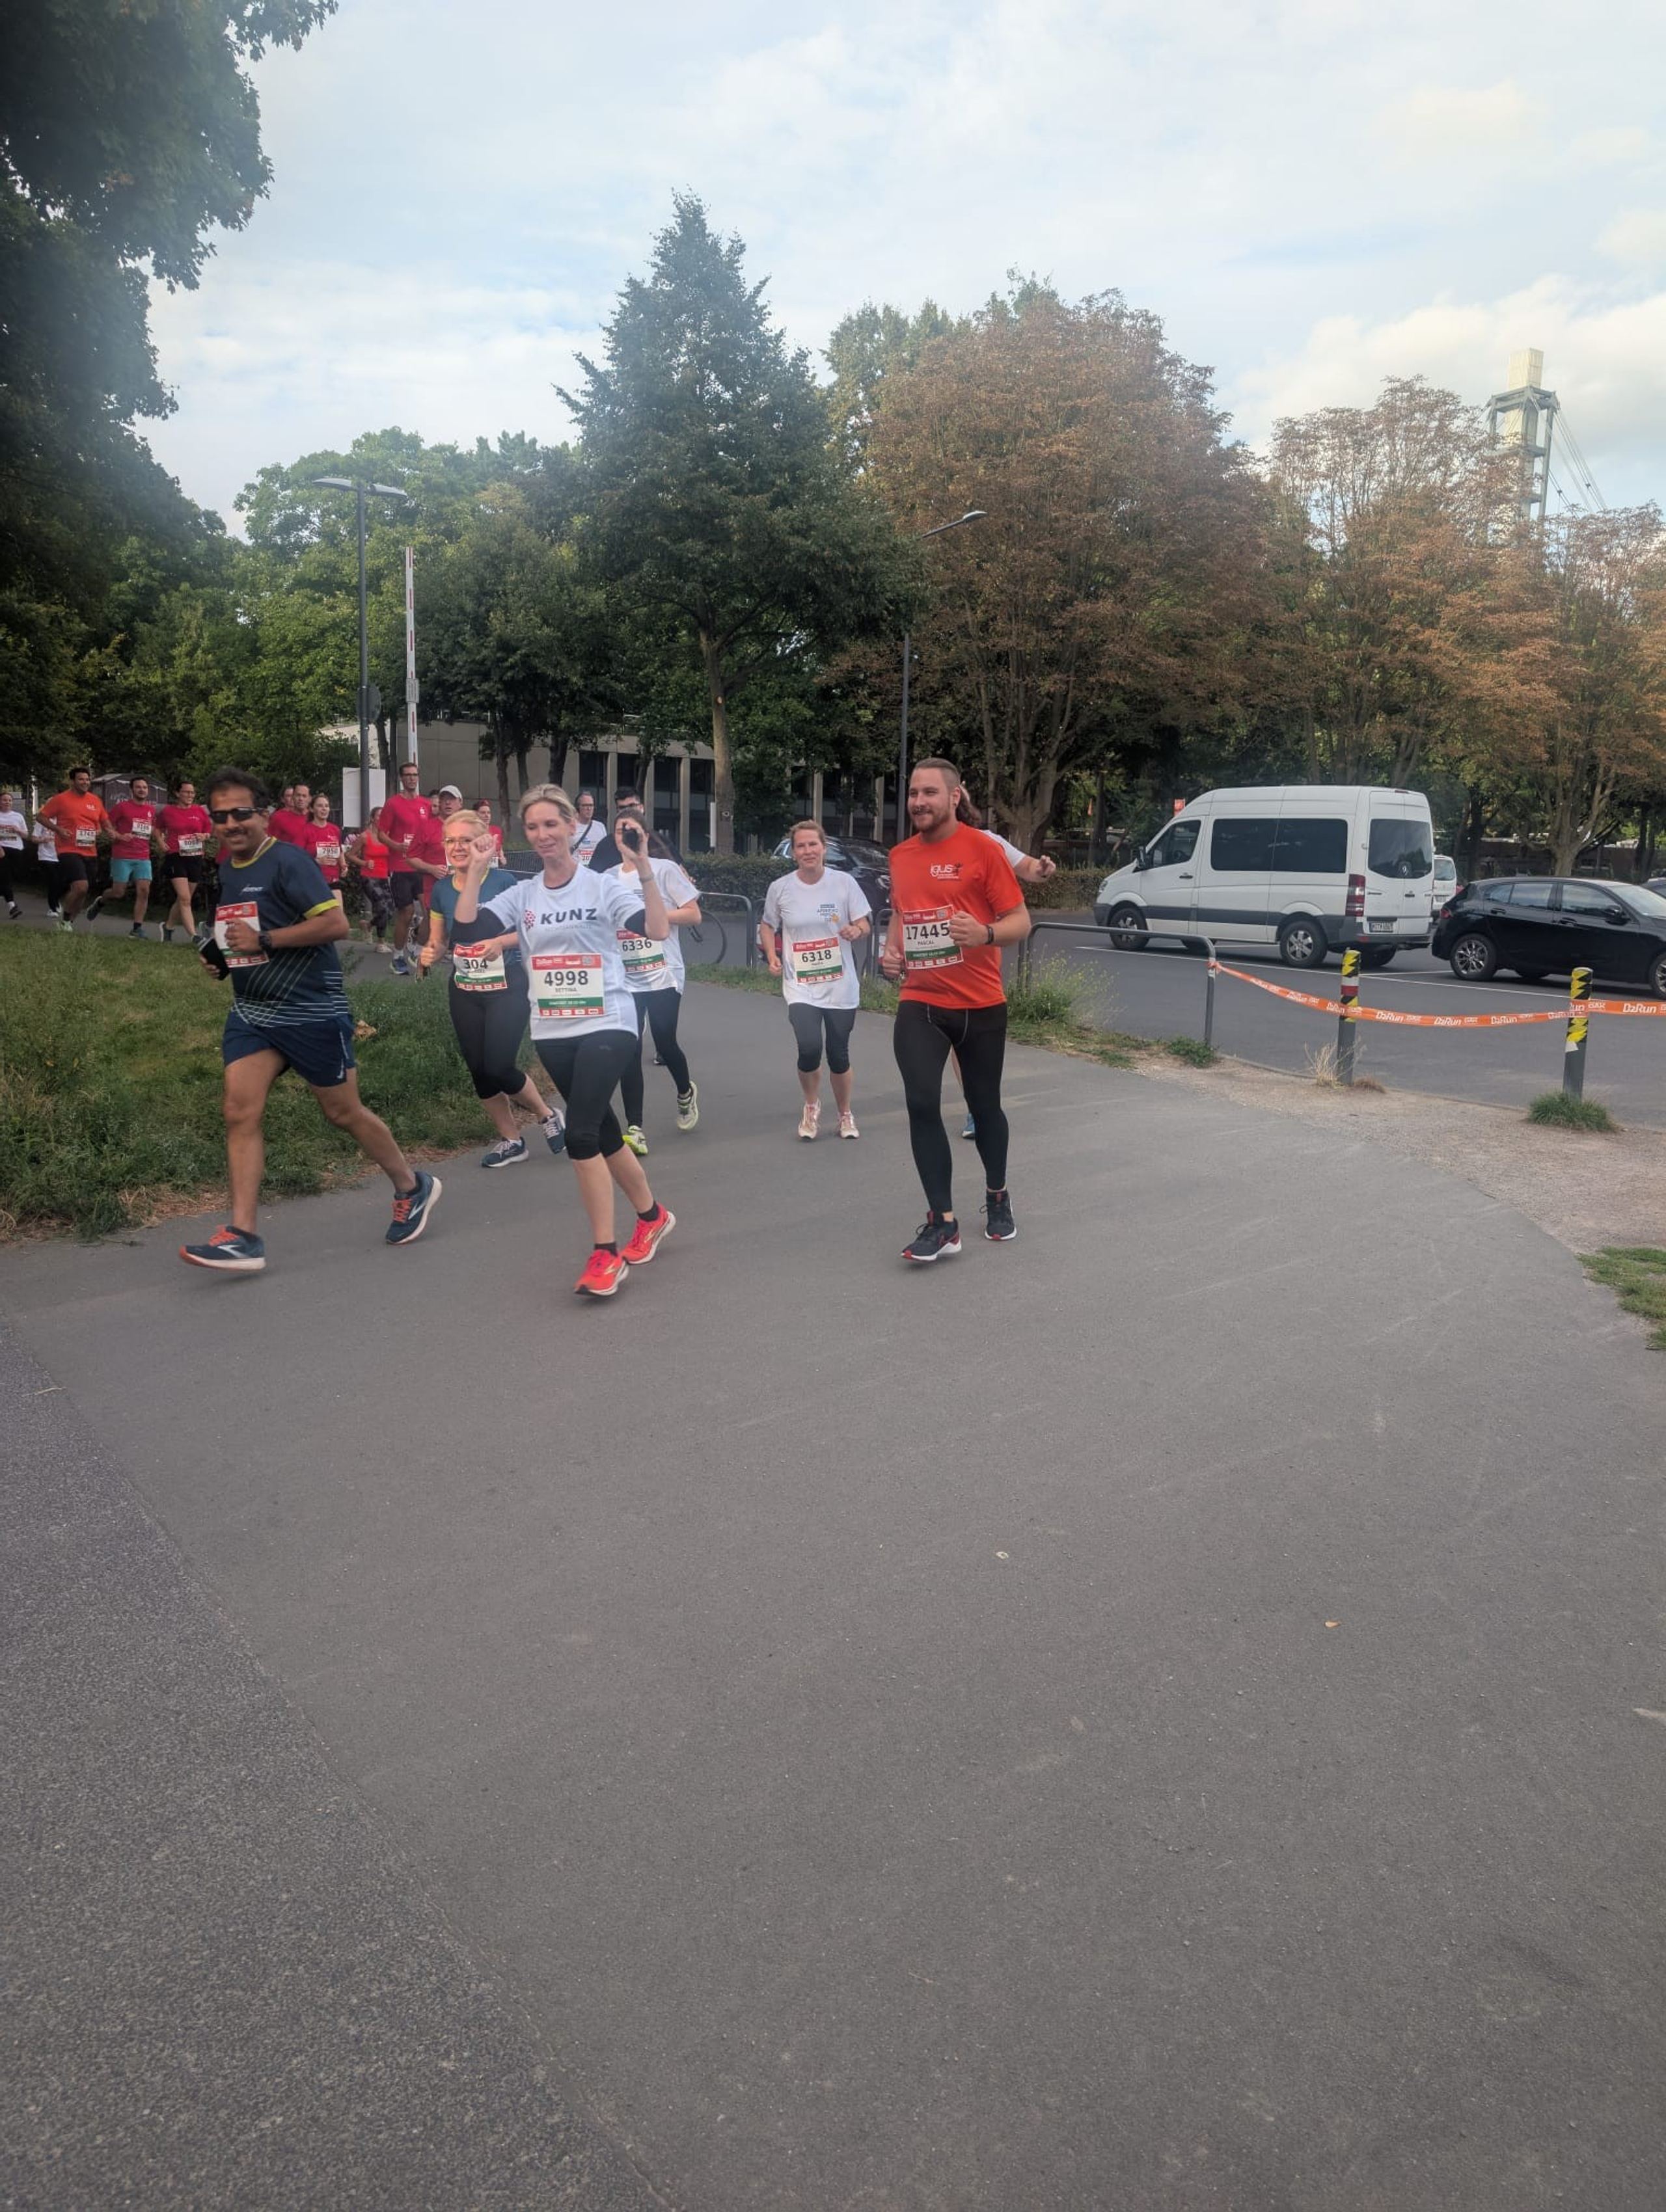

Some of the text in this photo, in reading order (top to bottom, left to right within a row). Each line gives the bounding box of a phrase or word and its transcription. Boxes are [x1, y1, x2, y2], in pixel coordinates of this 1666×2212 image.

[931, 864, 953, 877] igus
[540, 908, 597, 924] KUNZ
[906, 923, 950, 940] 17445
[622, 938, 652, 951] 6336
[802, 950, 832, 962] 6318
[463, 959, 488, 969] 304
[544, 970, 588, 986] 4998
[1623, 1003, 1657, 1014] DaRun
[1375, 1010, 1404, 1022] DaRun
[1434, 1016, 1462, 1026] DaRun
[1491, 1016, 1518, 1025] DaRun
